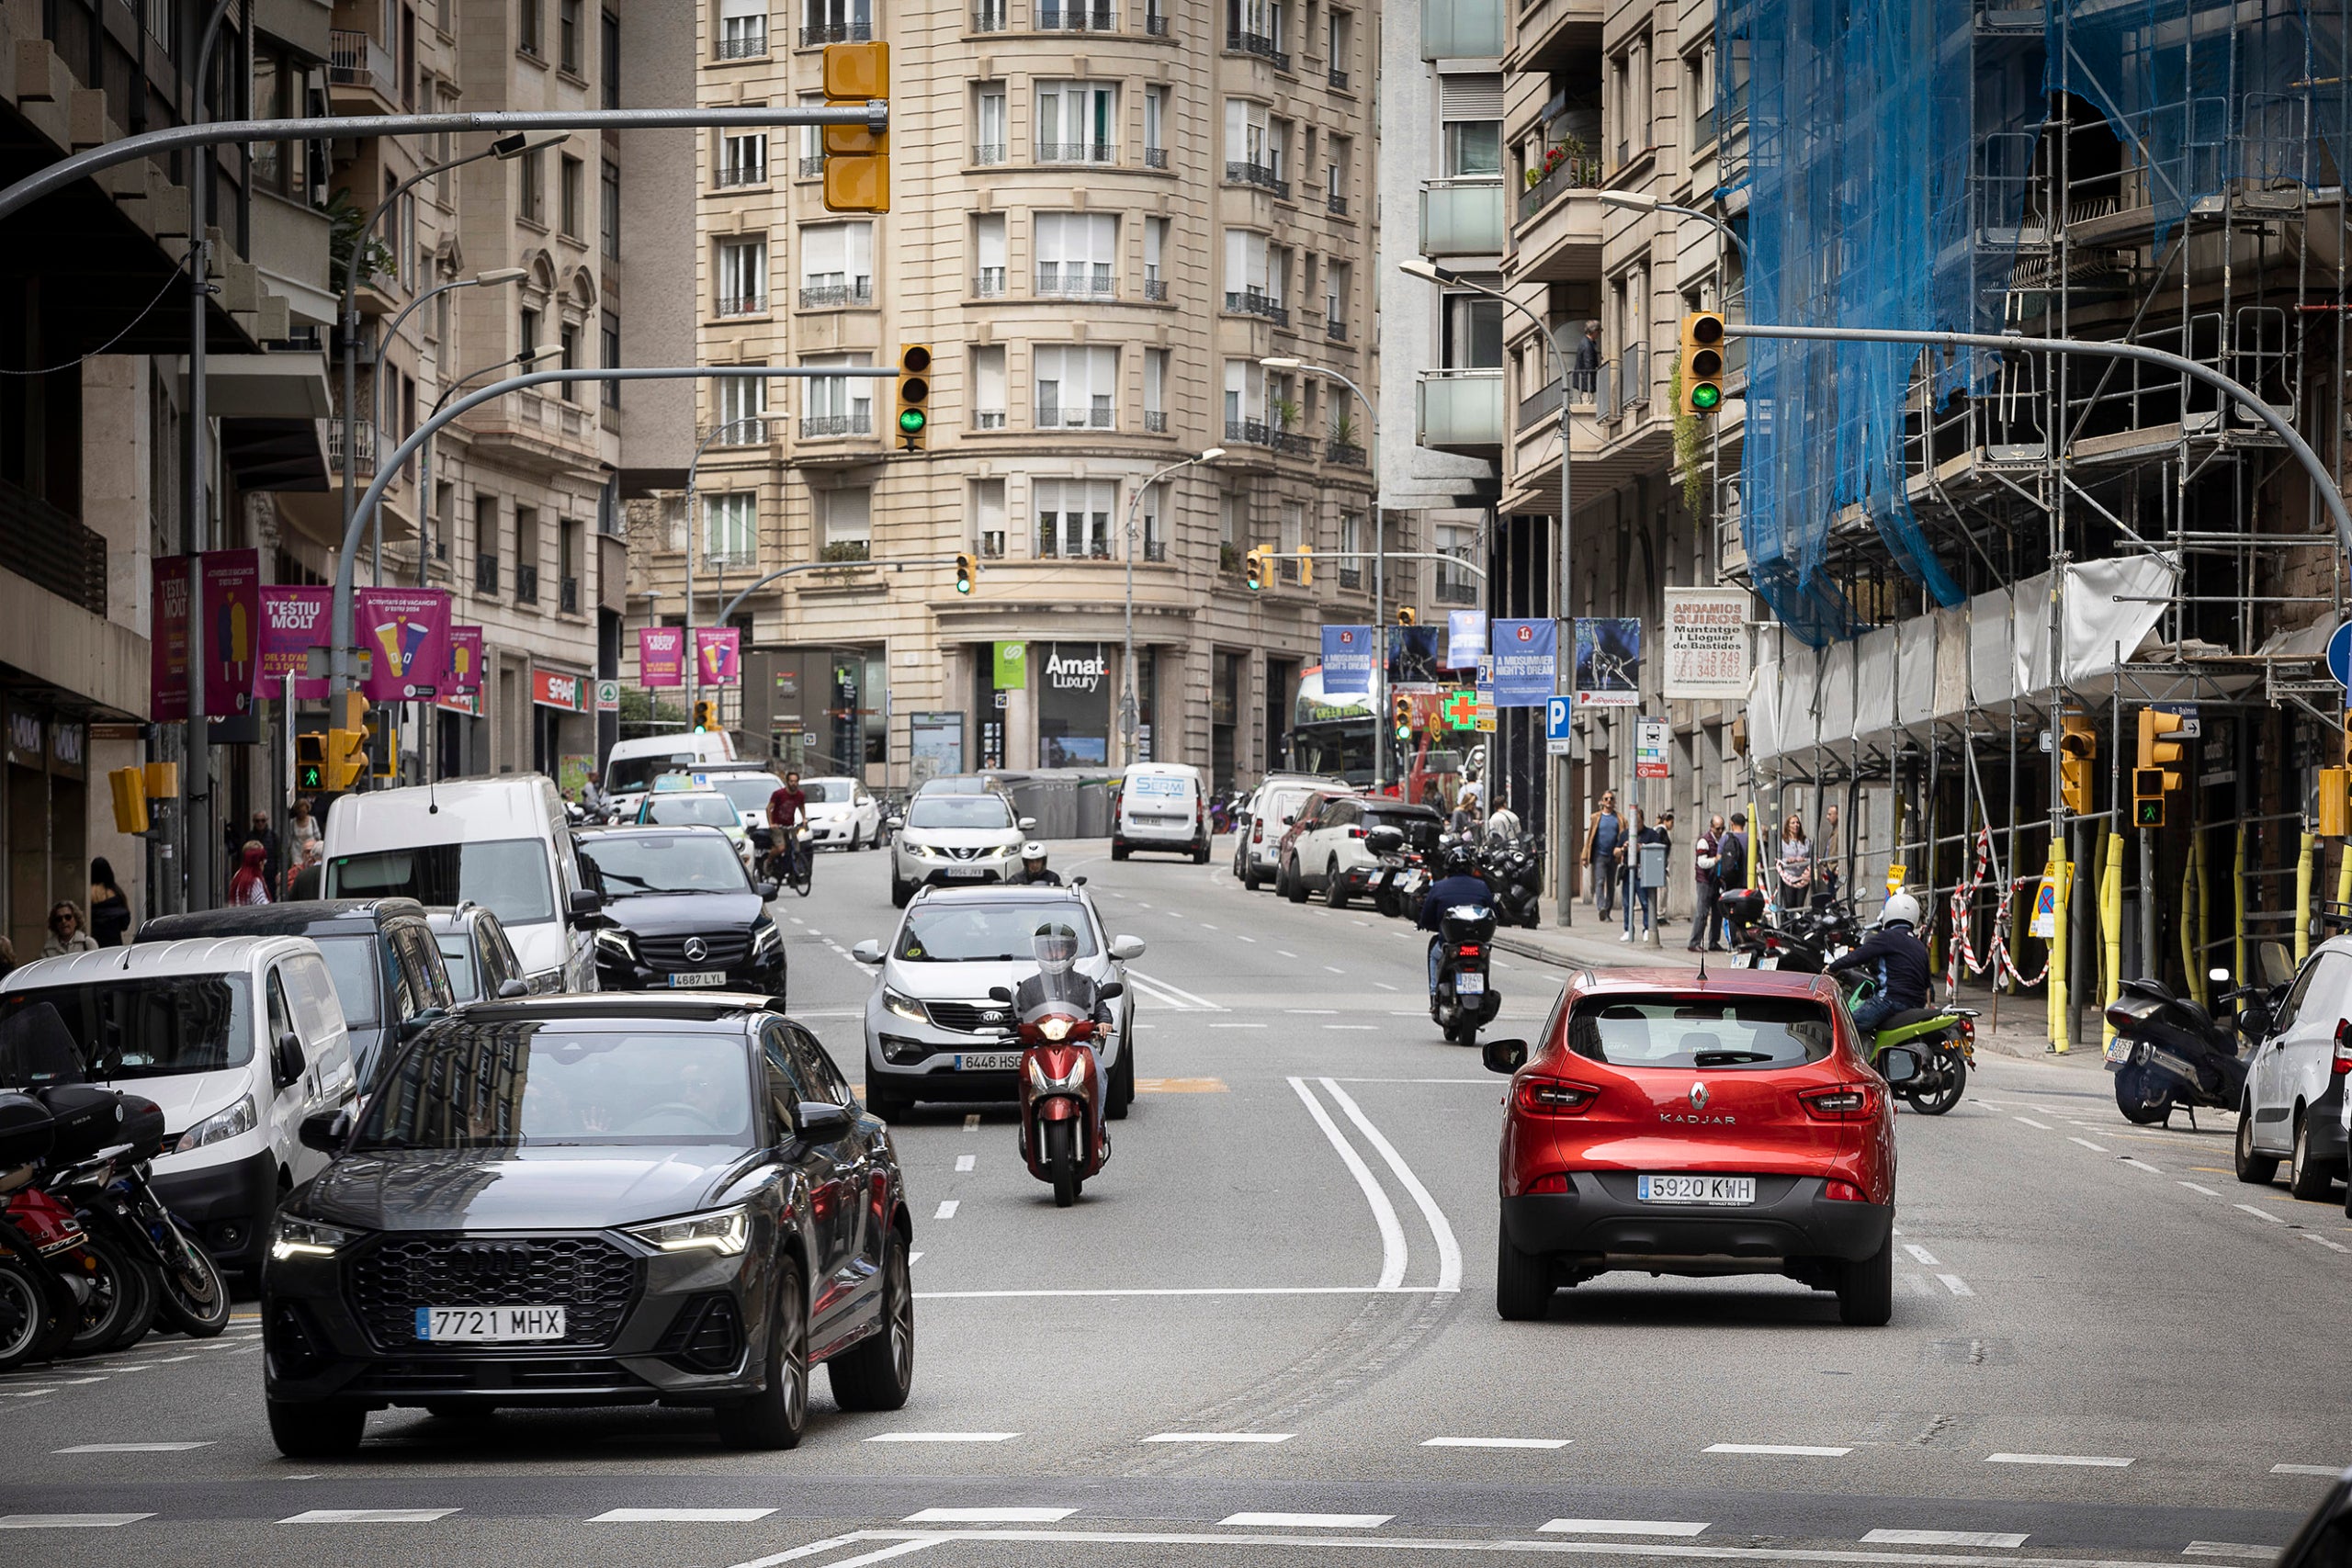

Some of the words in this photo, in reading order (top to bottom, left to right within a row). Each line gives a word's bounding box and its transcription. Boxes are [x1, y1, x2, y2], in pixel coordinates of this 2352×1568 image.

[266, 601, 321, 615] T'ESTIU
[1673, 604, 1742, 614] ANDAMIOS
[272, 615, 315, 629] MOLT
[1673, 615, 1742, 625] QUIROS
[1674, 626, 1740, 635] Muntatge
[1687, 634, 1735, 643] Lloguer
[1690, 642, 1742, 650] Bastides
[1498, 656, 1503, 665] A
[1504, 656, 1554, 665] MIDSUMMER
[1674, 651, 1693, 663] 622
[1698, 651, 1716, 663] 545
[1720, 651, 1740, 663] 249
[1348, 661, 1369, 671] DREAM
[1496, 665, 1525, 676] NIGHT'S
[1527, 665, 1555, 676] DREAM
[1674, 665, 1692, 678] 661
[1698, 665, 1716, 678] 348
[1720, 665, 1740, 678] 682
[1053, 673, 1099, 693] Luxury
[548, 677, 573, 702] SPAR
[1550, 700, 1566, 735] P
[676, 975, 701, 985] 4687
[704, 974, 723, 985] LYL
[966, 1056, 996, 1068] 6446
[1660, 1113, 1736, 1124] KADJAR
[1654, 1178, 1703, 1197] 5920
[1713, 1179, 1749, 1198] KWH
[435, 1311, 498, 1335] 7721
[511, 1310, 559, 1334] MHX
